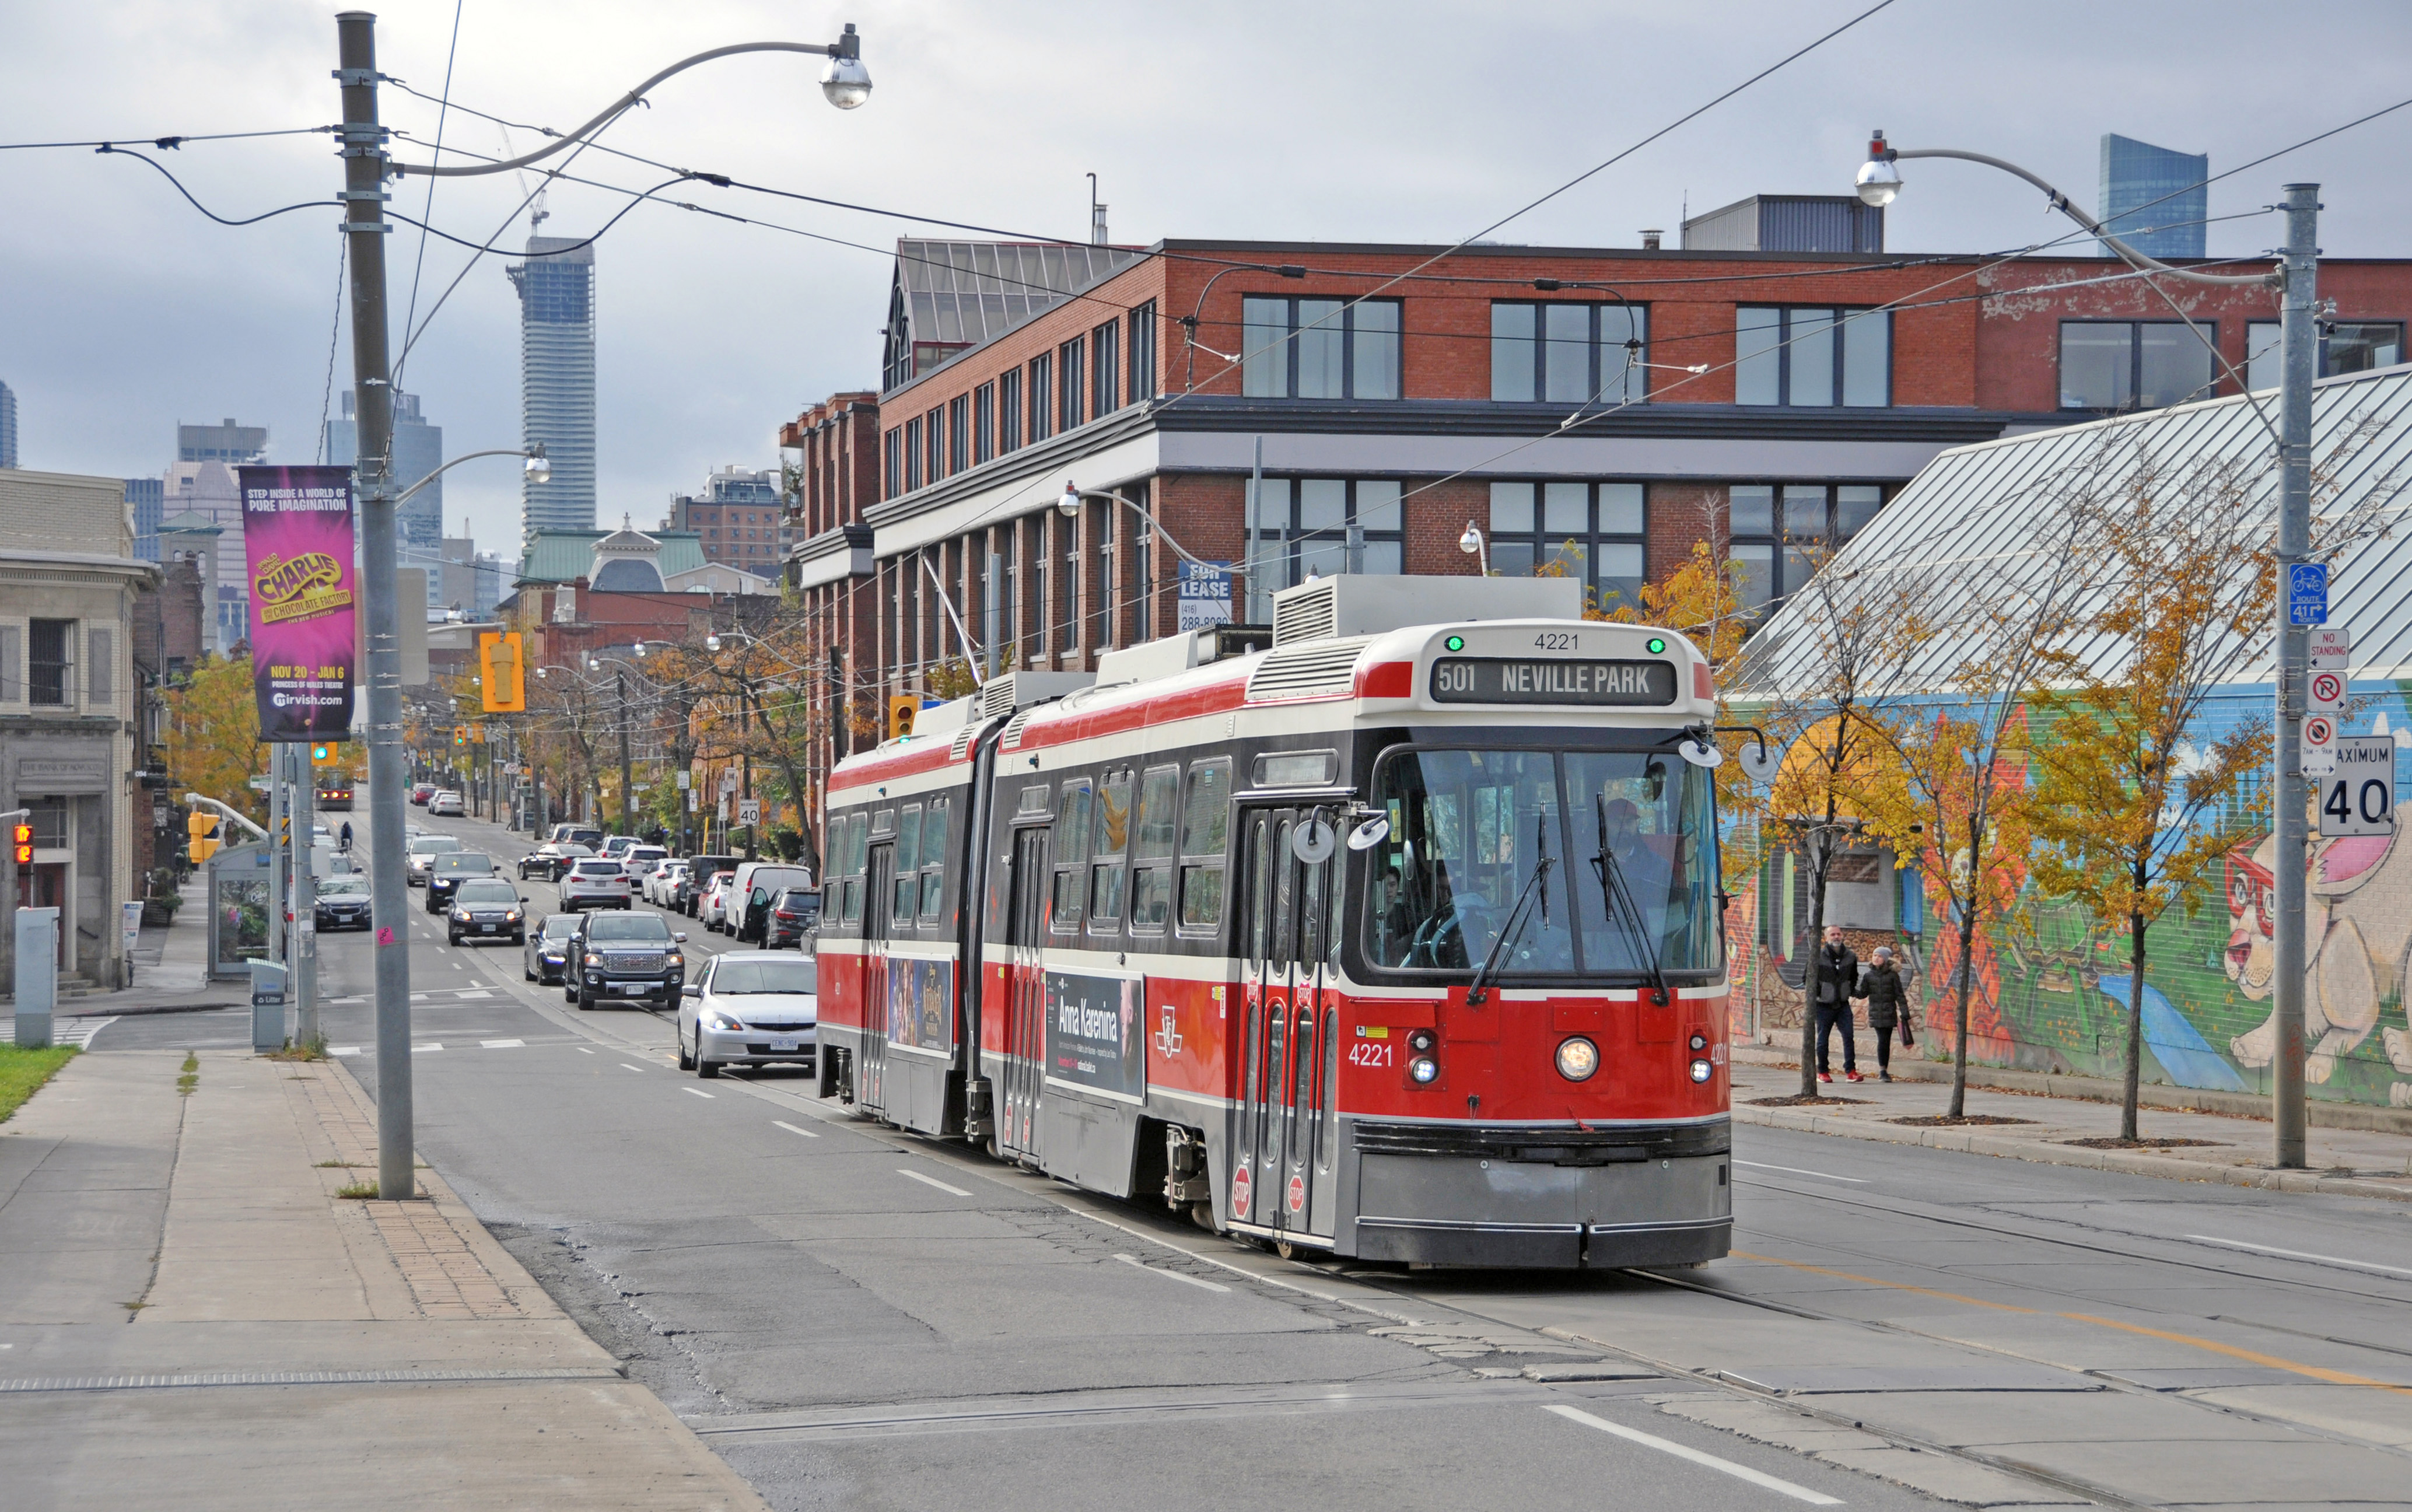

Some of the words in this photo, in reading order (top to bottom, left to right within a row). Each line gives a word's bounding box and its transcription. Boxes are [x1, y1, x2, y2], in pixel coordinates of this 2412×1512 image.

[248, 489, 268, 499] STEP
[269, 488, 296, 498] INSIDE
[298, 489, 304, 498] A
[306, 488, 334, 498] WORLD
[336, 488, 346, 498] OF
[249, 499, 276, 512] PURE
[279, 499, 347, 512] IMAGINATION
[257, 555, 337, 600] CHARLIE
[1190, 564, 1220, 579] FOR
[1181, 582, 1228, 597] LEASE
[274, 598, 319, 617] CHOCOLATE
[321, 592, 349, 607] FACTORY
[1181, 604, 1196, 615] (416)
[2293, 606, 2308, 617] 41
[1535, 634, 1578, 650] 4221
[2323, 634, 2335, 642] NO
[2311, 646, 2346, 656] STANDING
[271, 666, 291, 678] NOV
[295, 666, 307, 678] 20
[318, 666, 335, 678] JAN
[338, 666, 344, 679] 6
[1439, 664, 1475, 691] 501
[1503, 665, 1588, 692] NEVILLE
[1595, 666, 1650, 693] PARK
[273, 692, 342, 707] mirvish.com
[2337, 748, 2388, 763] AXIMUM
[2324, 779, 2389, 824] 40
[741, 810, 758, 821] 40
[1248, 985, 1257, 995] STOP
[1298, 988, 1310, 999] STOP
[1059, 995, 1079, 1035] Anna
[1081, 998, 1118, 1042] Karenina
[1349, 1043, 1392, 1067] 4221
[1711, 1043, 1726, 1065] 4221
[1234, 1181, 1249, 1202] STOP
[1290, 1186, 1303, 1200] STOP
